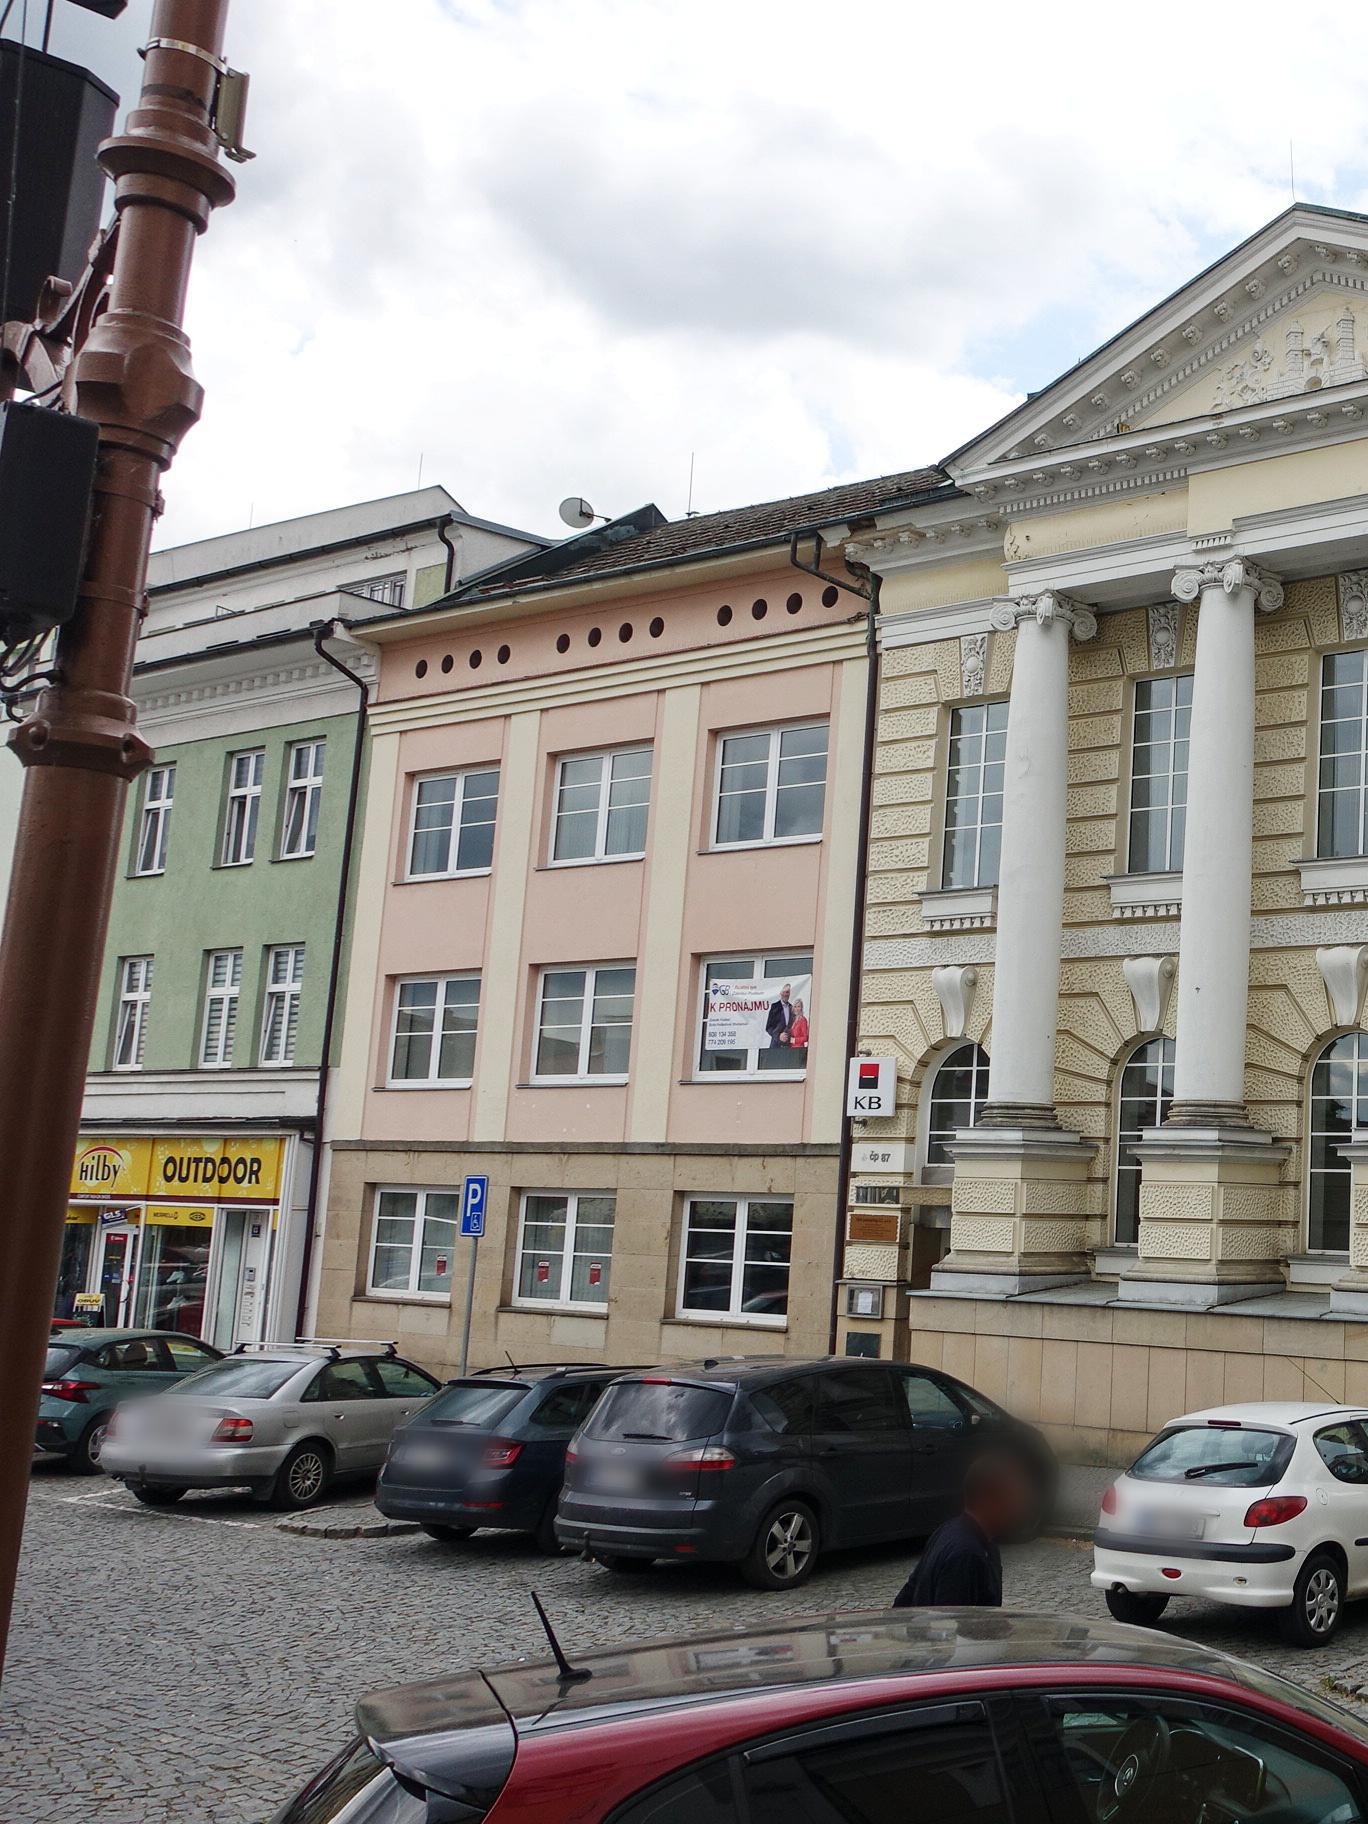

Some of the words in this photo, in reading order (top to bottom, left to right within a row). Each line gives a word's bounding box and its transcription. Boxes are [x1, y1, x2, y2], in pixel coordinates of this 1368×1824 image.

[710, 1002, 716, 1012] K
[719, 998, 770, 1012] PRONÁJMU
[854, 1095, 882, 1110] KB
[163, 1155, 262, 1185] OUTDOOR
[466, 1183, 482, 1217] P
[103, 1210, 122, 1220] GLS
